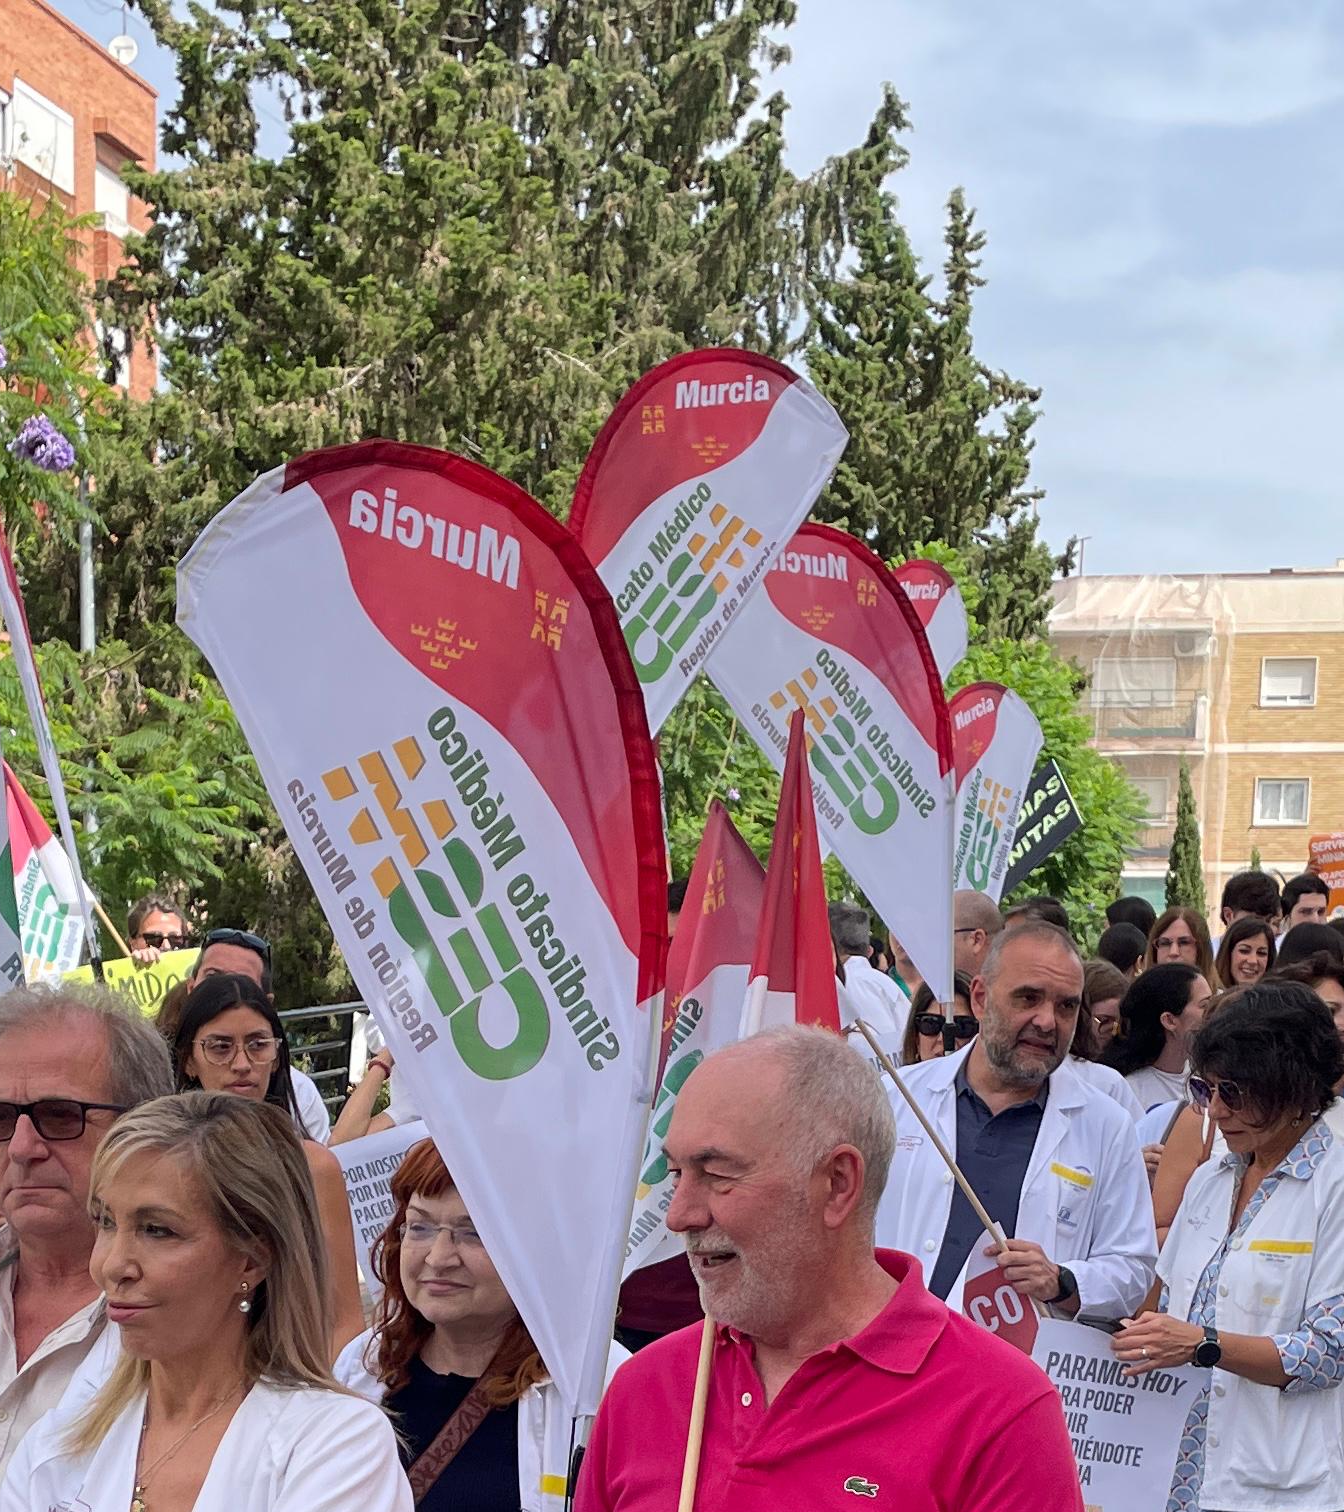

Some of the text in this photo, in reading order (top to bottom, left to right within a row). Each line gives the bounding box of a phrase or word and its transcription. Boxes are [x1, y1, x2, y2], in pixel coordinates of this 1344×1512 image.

[674, 374, 771, 410] Murcia
[616, 481, 712, 622] cato Médico
[678, 619, 723, 678] Región
[722, 597, 739, 622] de
[955, 697, 996, 730] Murcia
[343, 1152, 406, 1183] POR NOSOT
[347, 1184, 374, 1205] POR
[1142, 1369, 1188, 1396] HOY
[1083, 1389, 1135, 1415] PODER
